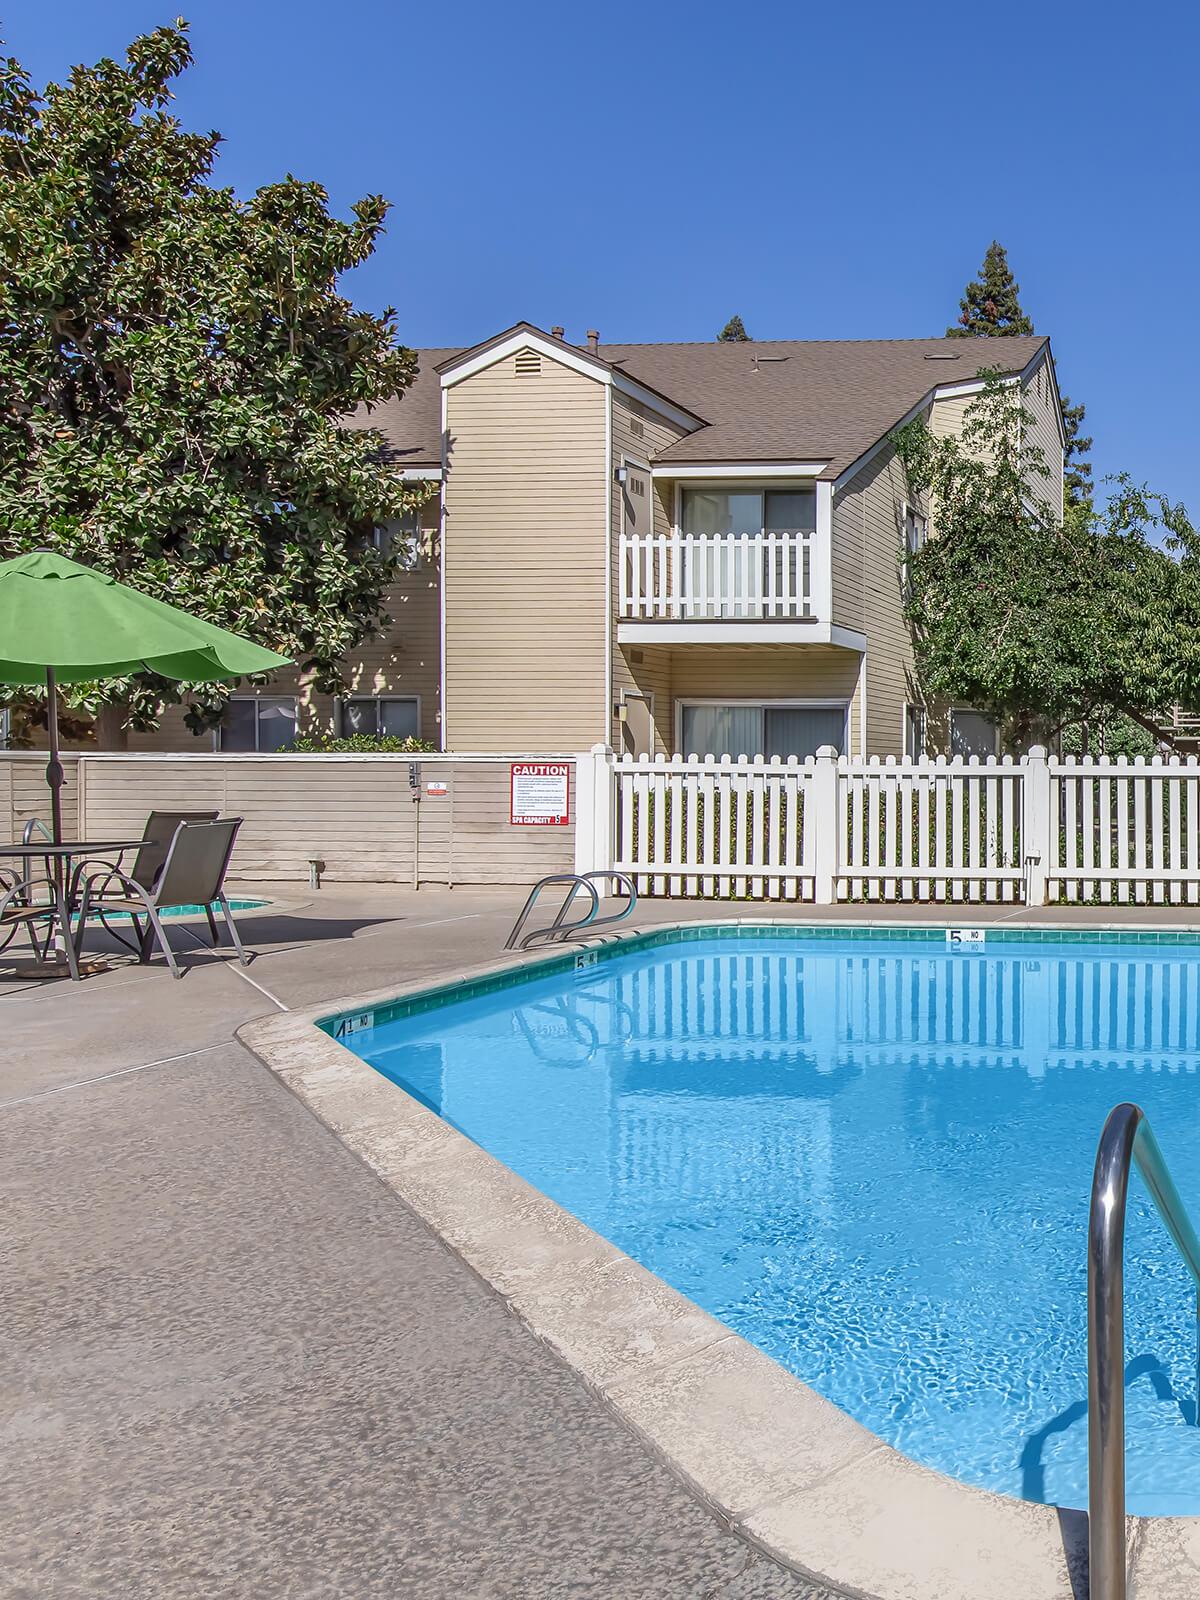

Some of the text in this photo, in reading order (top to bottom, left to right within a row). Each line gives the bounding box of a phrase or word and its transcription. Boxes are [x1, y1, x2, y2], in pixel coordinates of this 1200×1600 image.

[513, 765, 567, 775] CAUTION
[555, 815, 560, 823] 5
[950, 931, 961, 944] 5
[360, 1015, 368, 1027] NO
